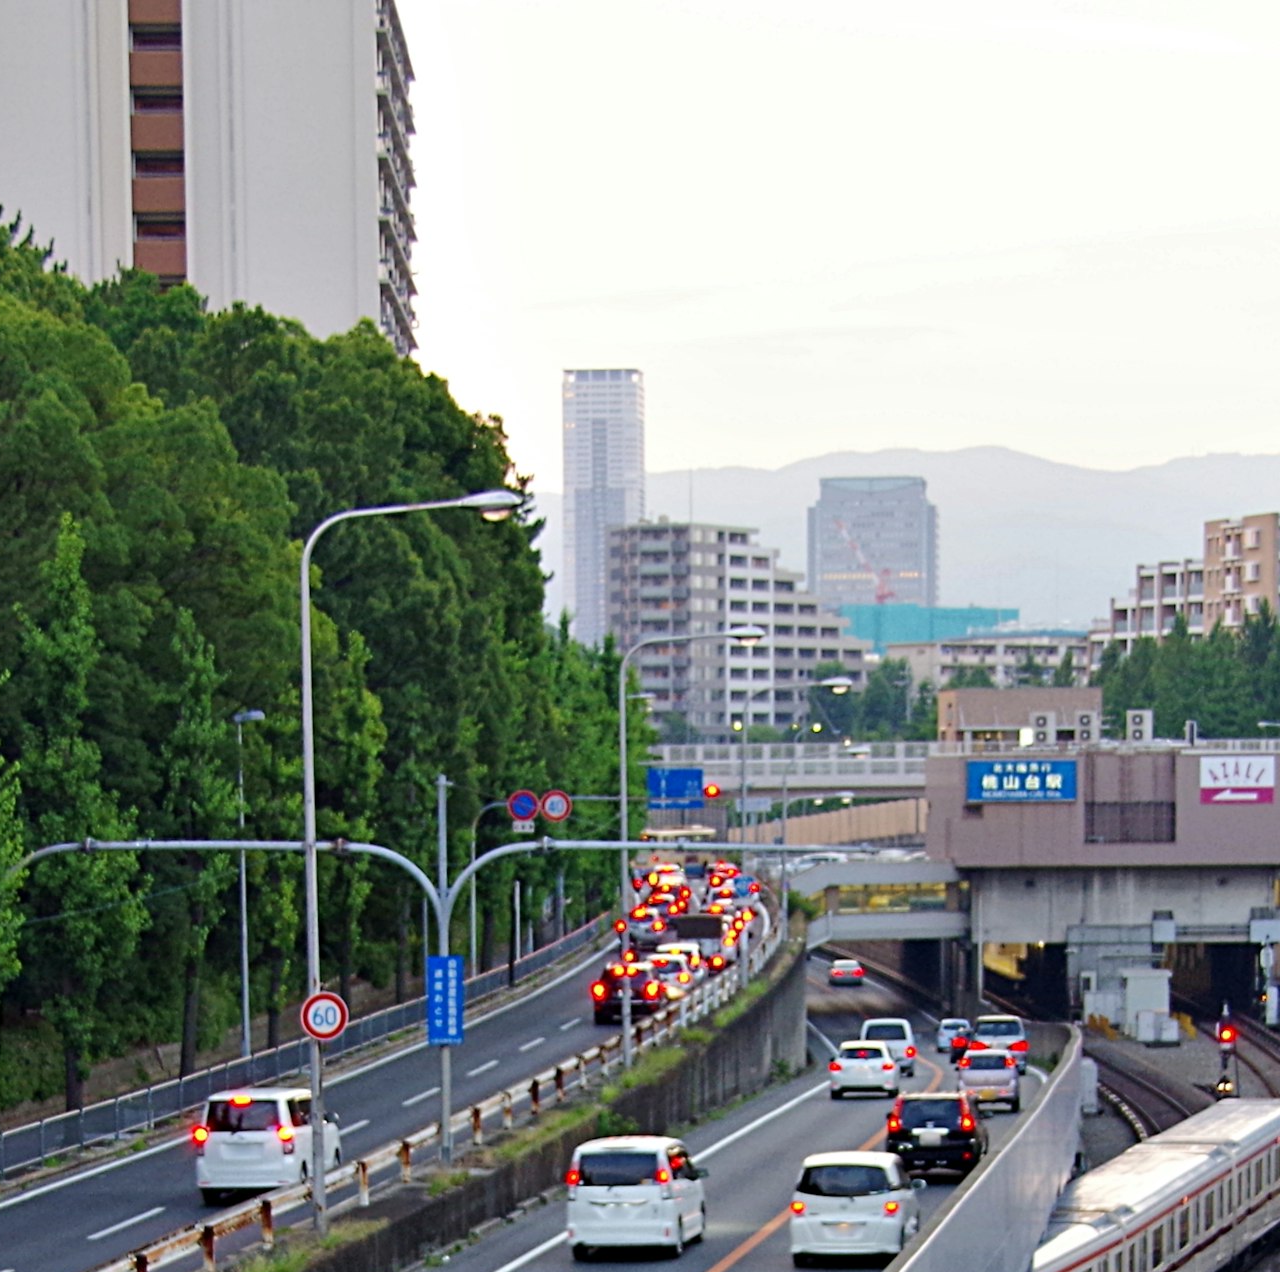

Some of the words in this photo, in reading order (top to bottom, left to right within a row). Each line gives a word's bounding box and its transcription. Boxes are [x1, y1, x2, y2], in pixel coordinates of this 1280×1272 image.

[981, 773, 1063, 790] 桃山台駅
[547, 799, 566, 814] 40
[313, 1006, 337, 1026] 60
